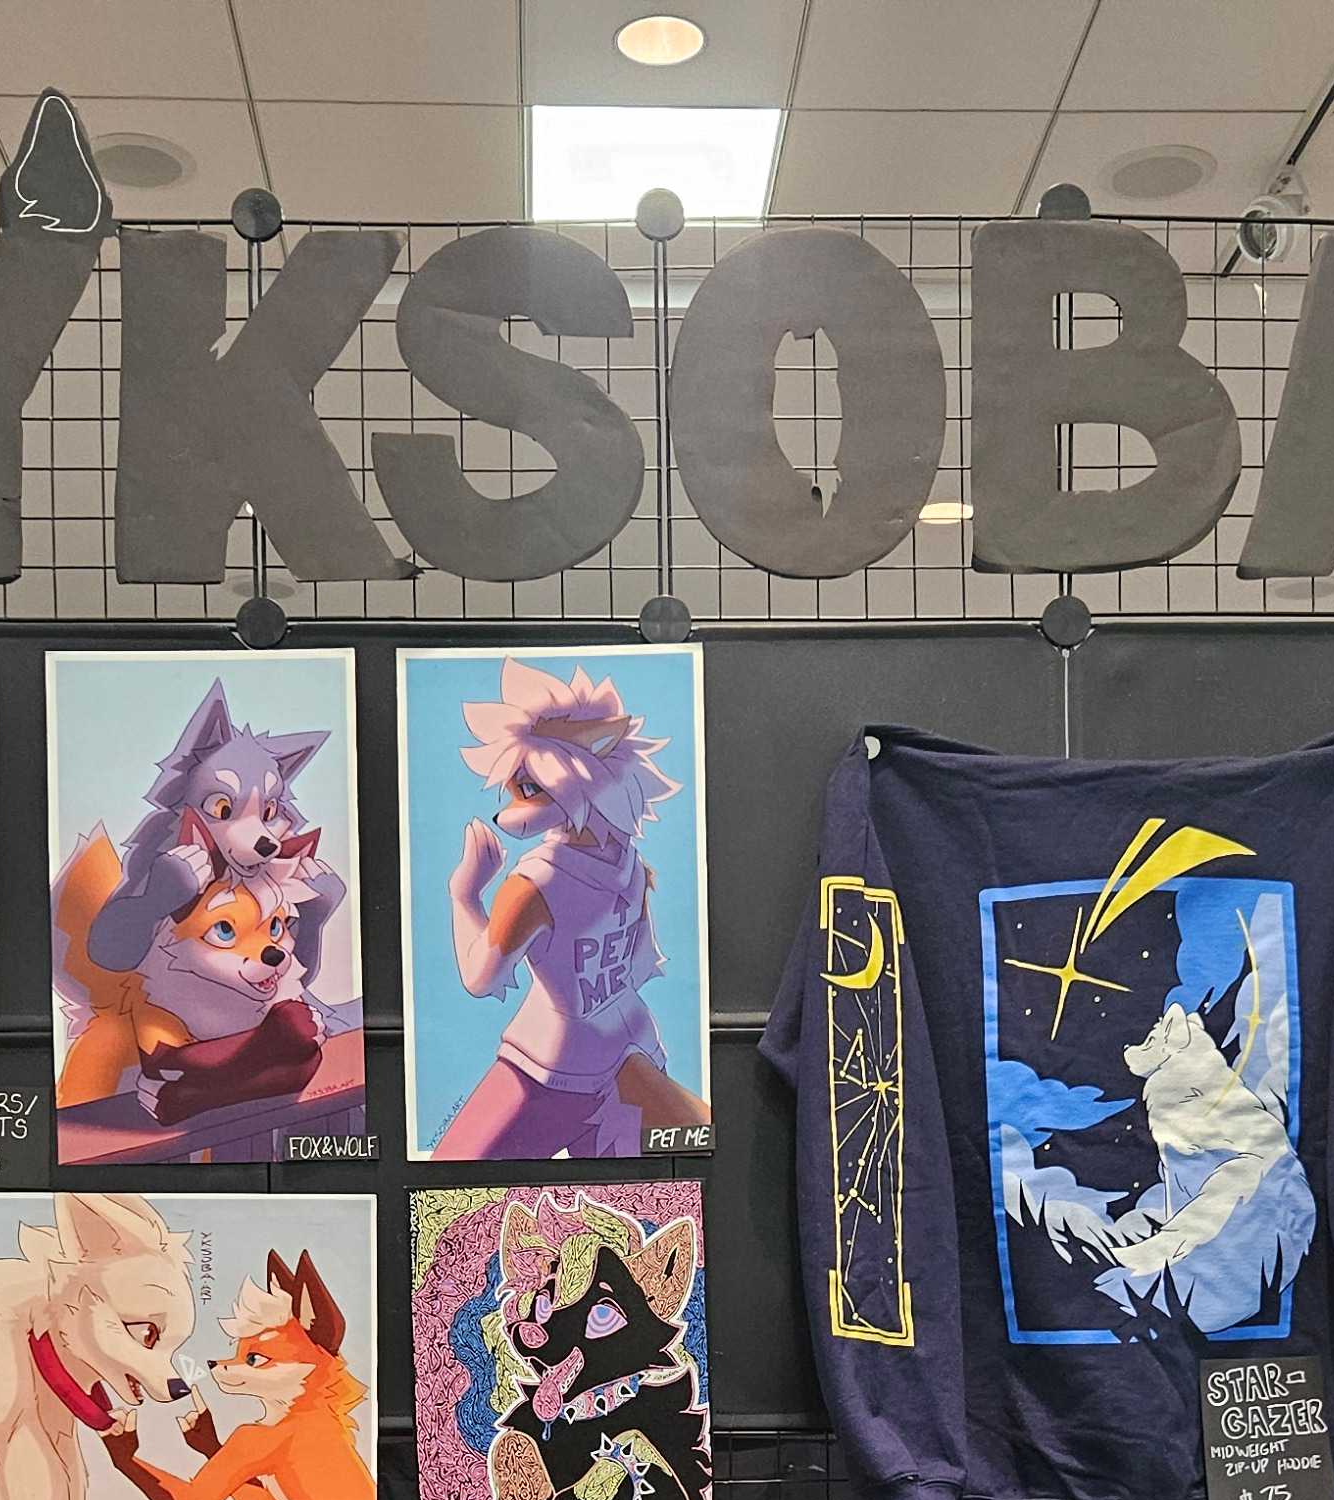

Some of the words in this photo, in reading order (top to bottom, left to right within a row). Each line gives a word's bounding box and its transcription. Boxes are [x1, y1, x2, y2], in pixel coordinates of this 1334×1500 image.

[574, 921, 639, 973] PET
[578, 964, 628, 1014] ME
[289, 1135, 378, 1159] FOX&WOLF
[647, 1128, 681, 1149] PET
[685, 1125, 710, 1147] ME
[1207, 1363, 1307, 1407] STAR-
[1221, 1398, 1328, 1440] GAZER
[1210, 1439, 1289, 1460] MIDWEIGHT
[1225, 1459, 1269, 1477] ZIP-UP
[1277, 1455, 1322, 1475] HOODIE
